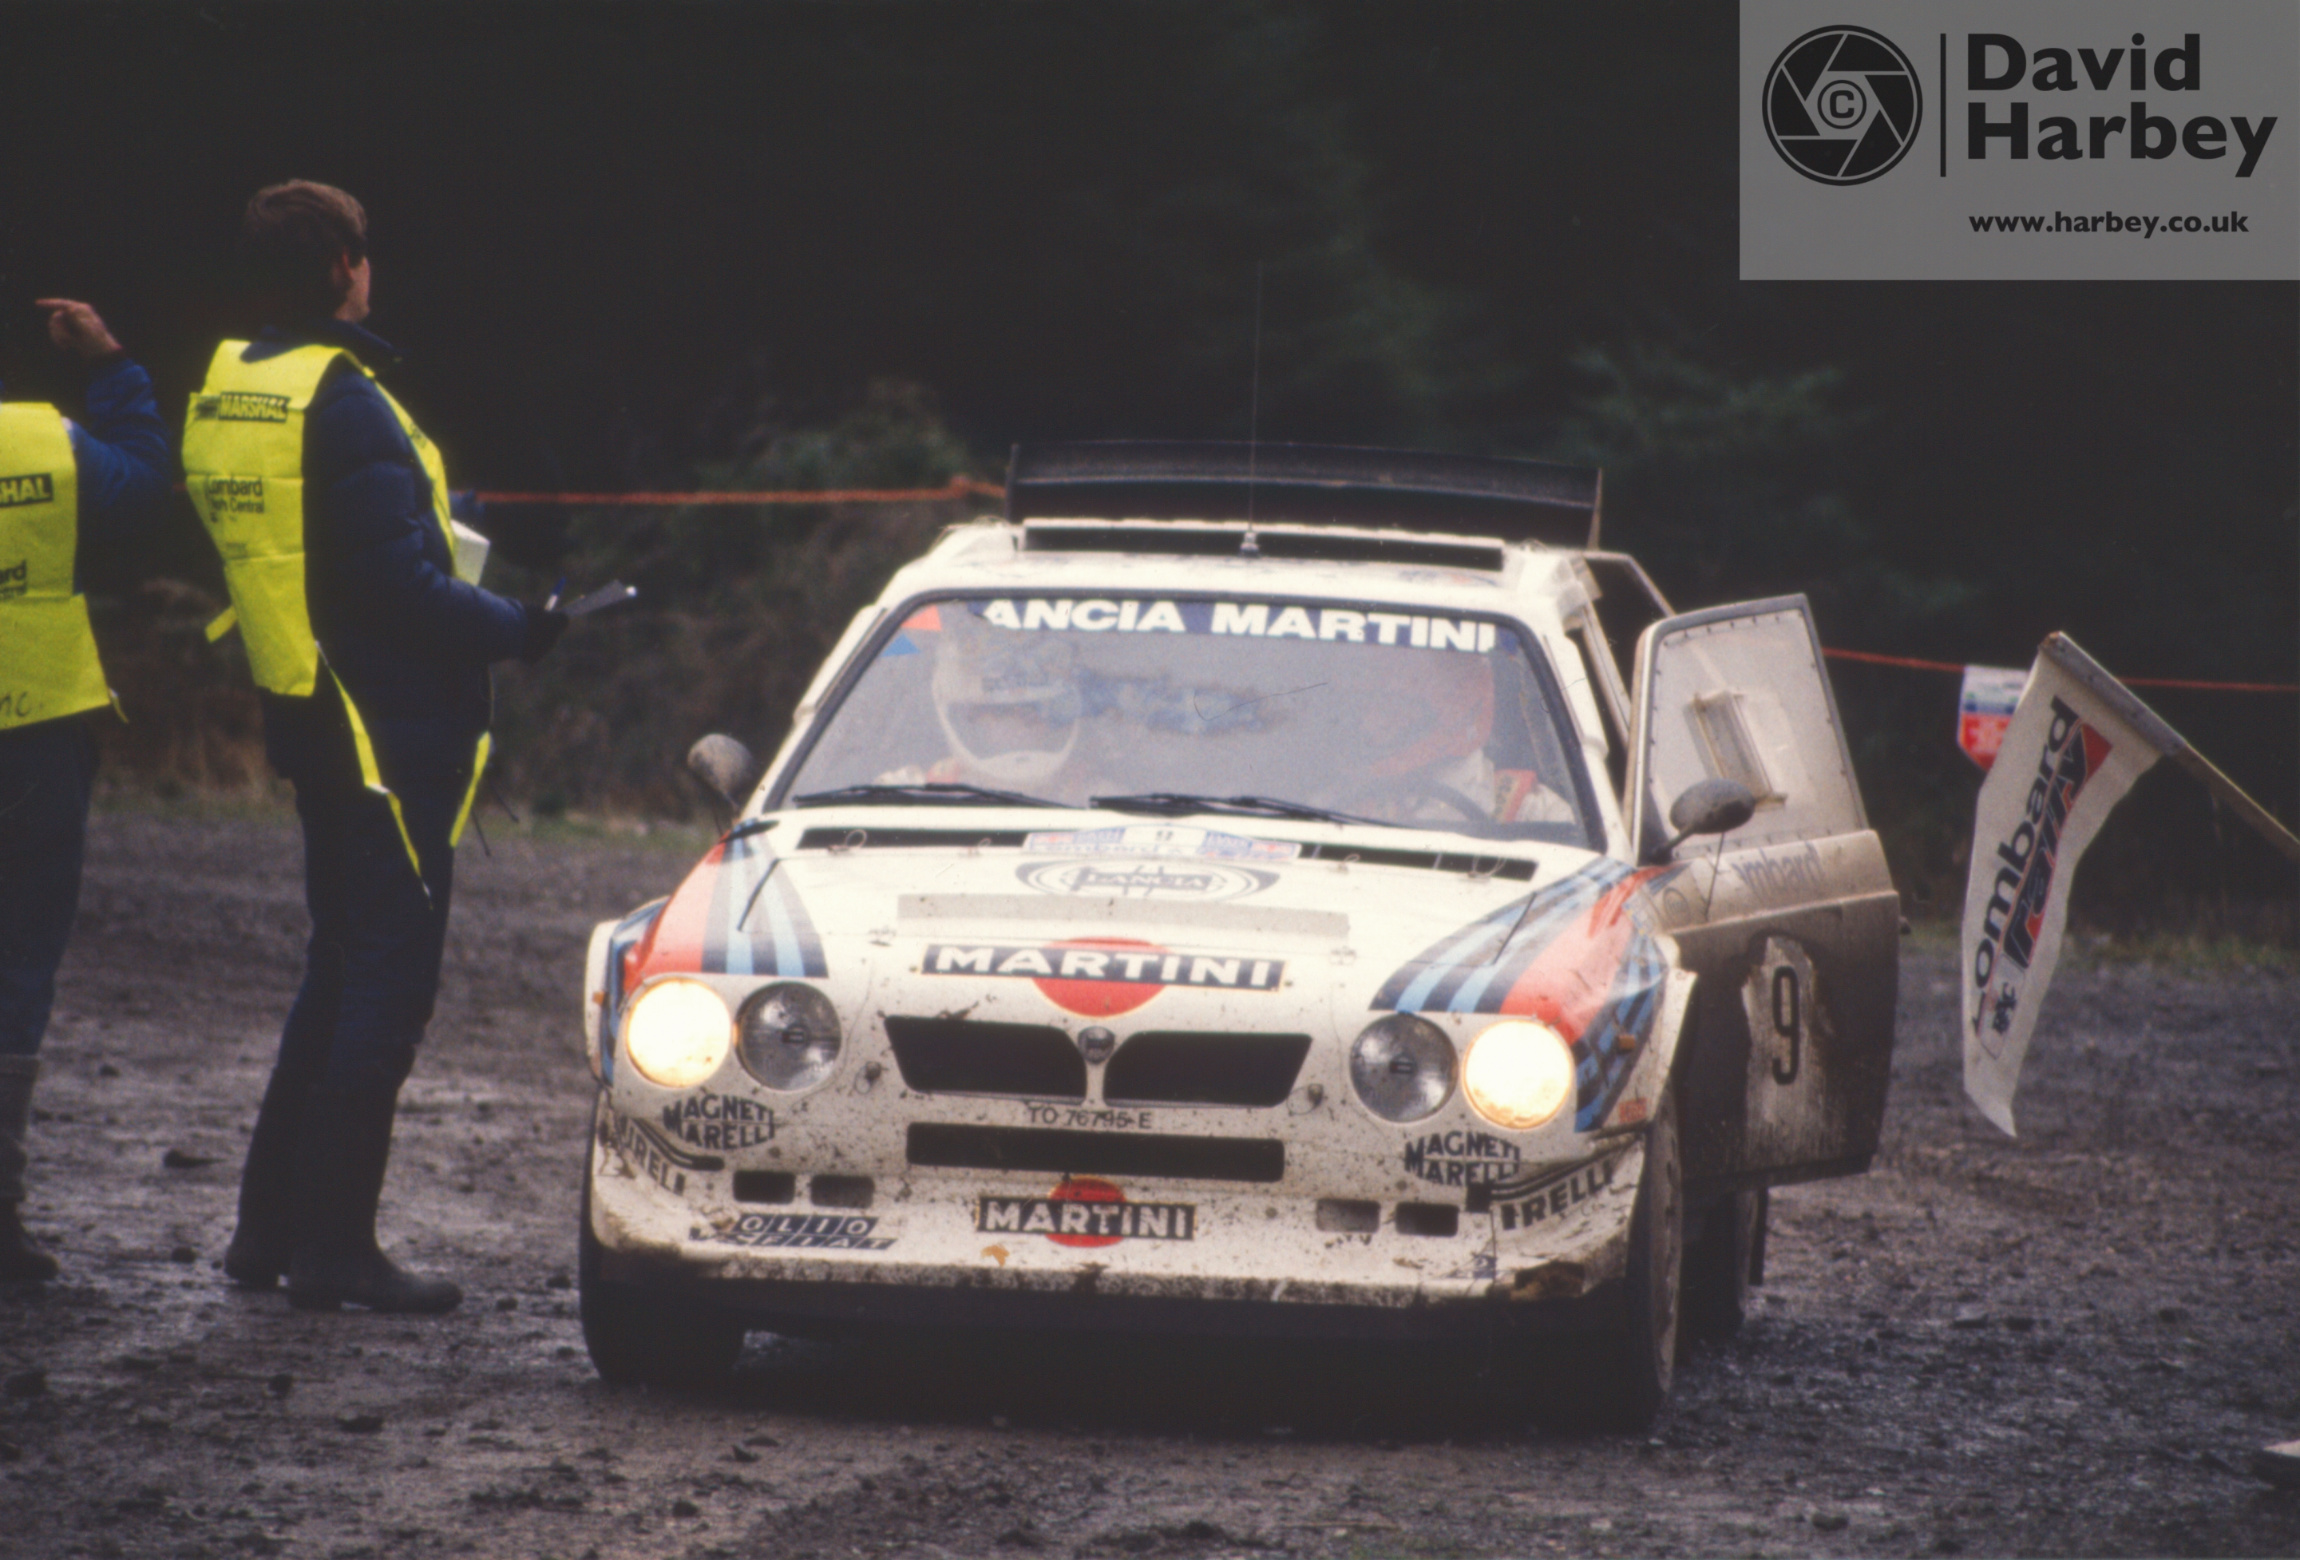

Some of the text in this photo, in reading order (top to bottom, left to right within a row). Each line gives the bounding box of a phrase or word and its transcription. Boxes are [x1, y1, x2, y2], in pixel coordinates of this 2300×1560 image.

[220, 393, 287, 420] MARSHAL
[985, 599, 1497, 654] ANCIA MARTINI
[935, 946, 1272, 987] MARTINI
[1771, 965, 1799, 1085] 9
[1027, 1104, 1060, 1125] TO
[741, 1215, 869, 1235] OLIO
[985, 1200, 1188, 1238] MARTINI
